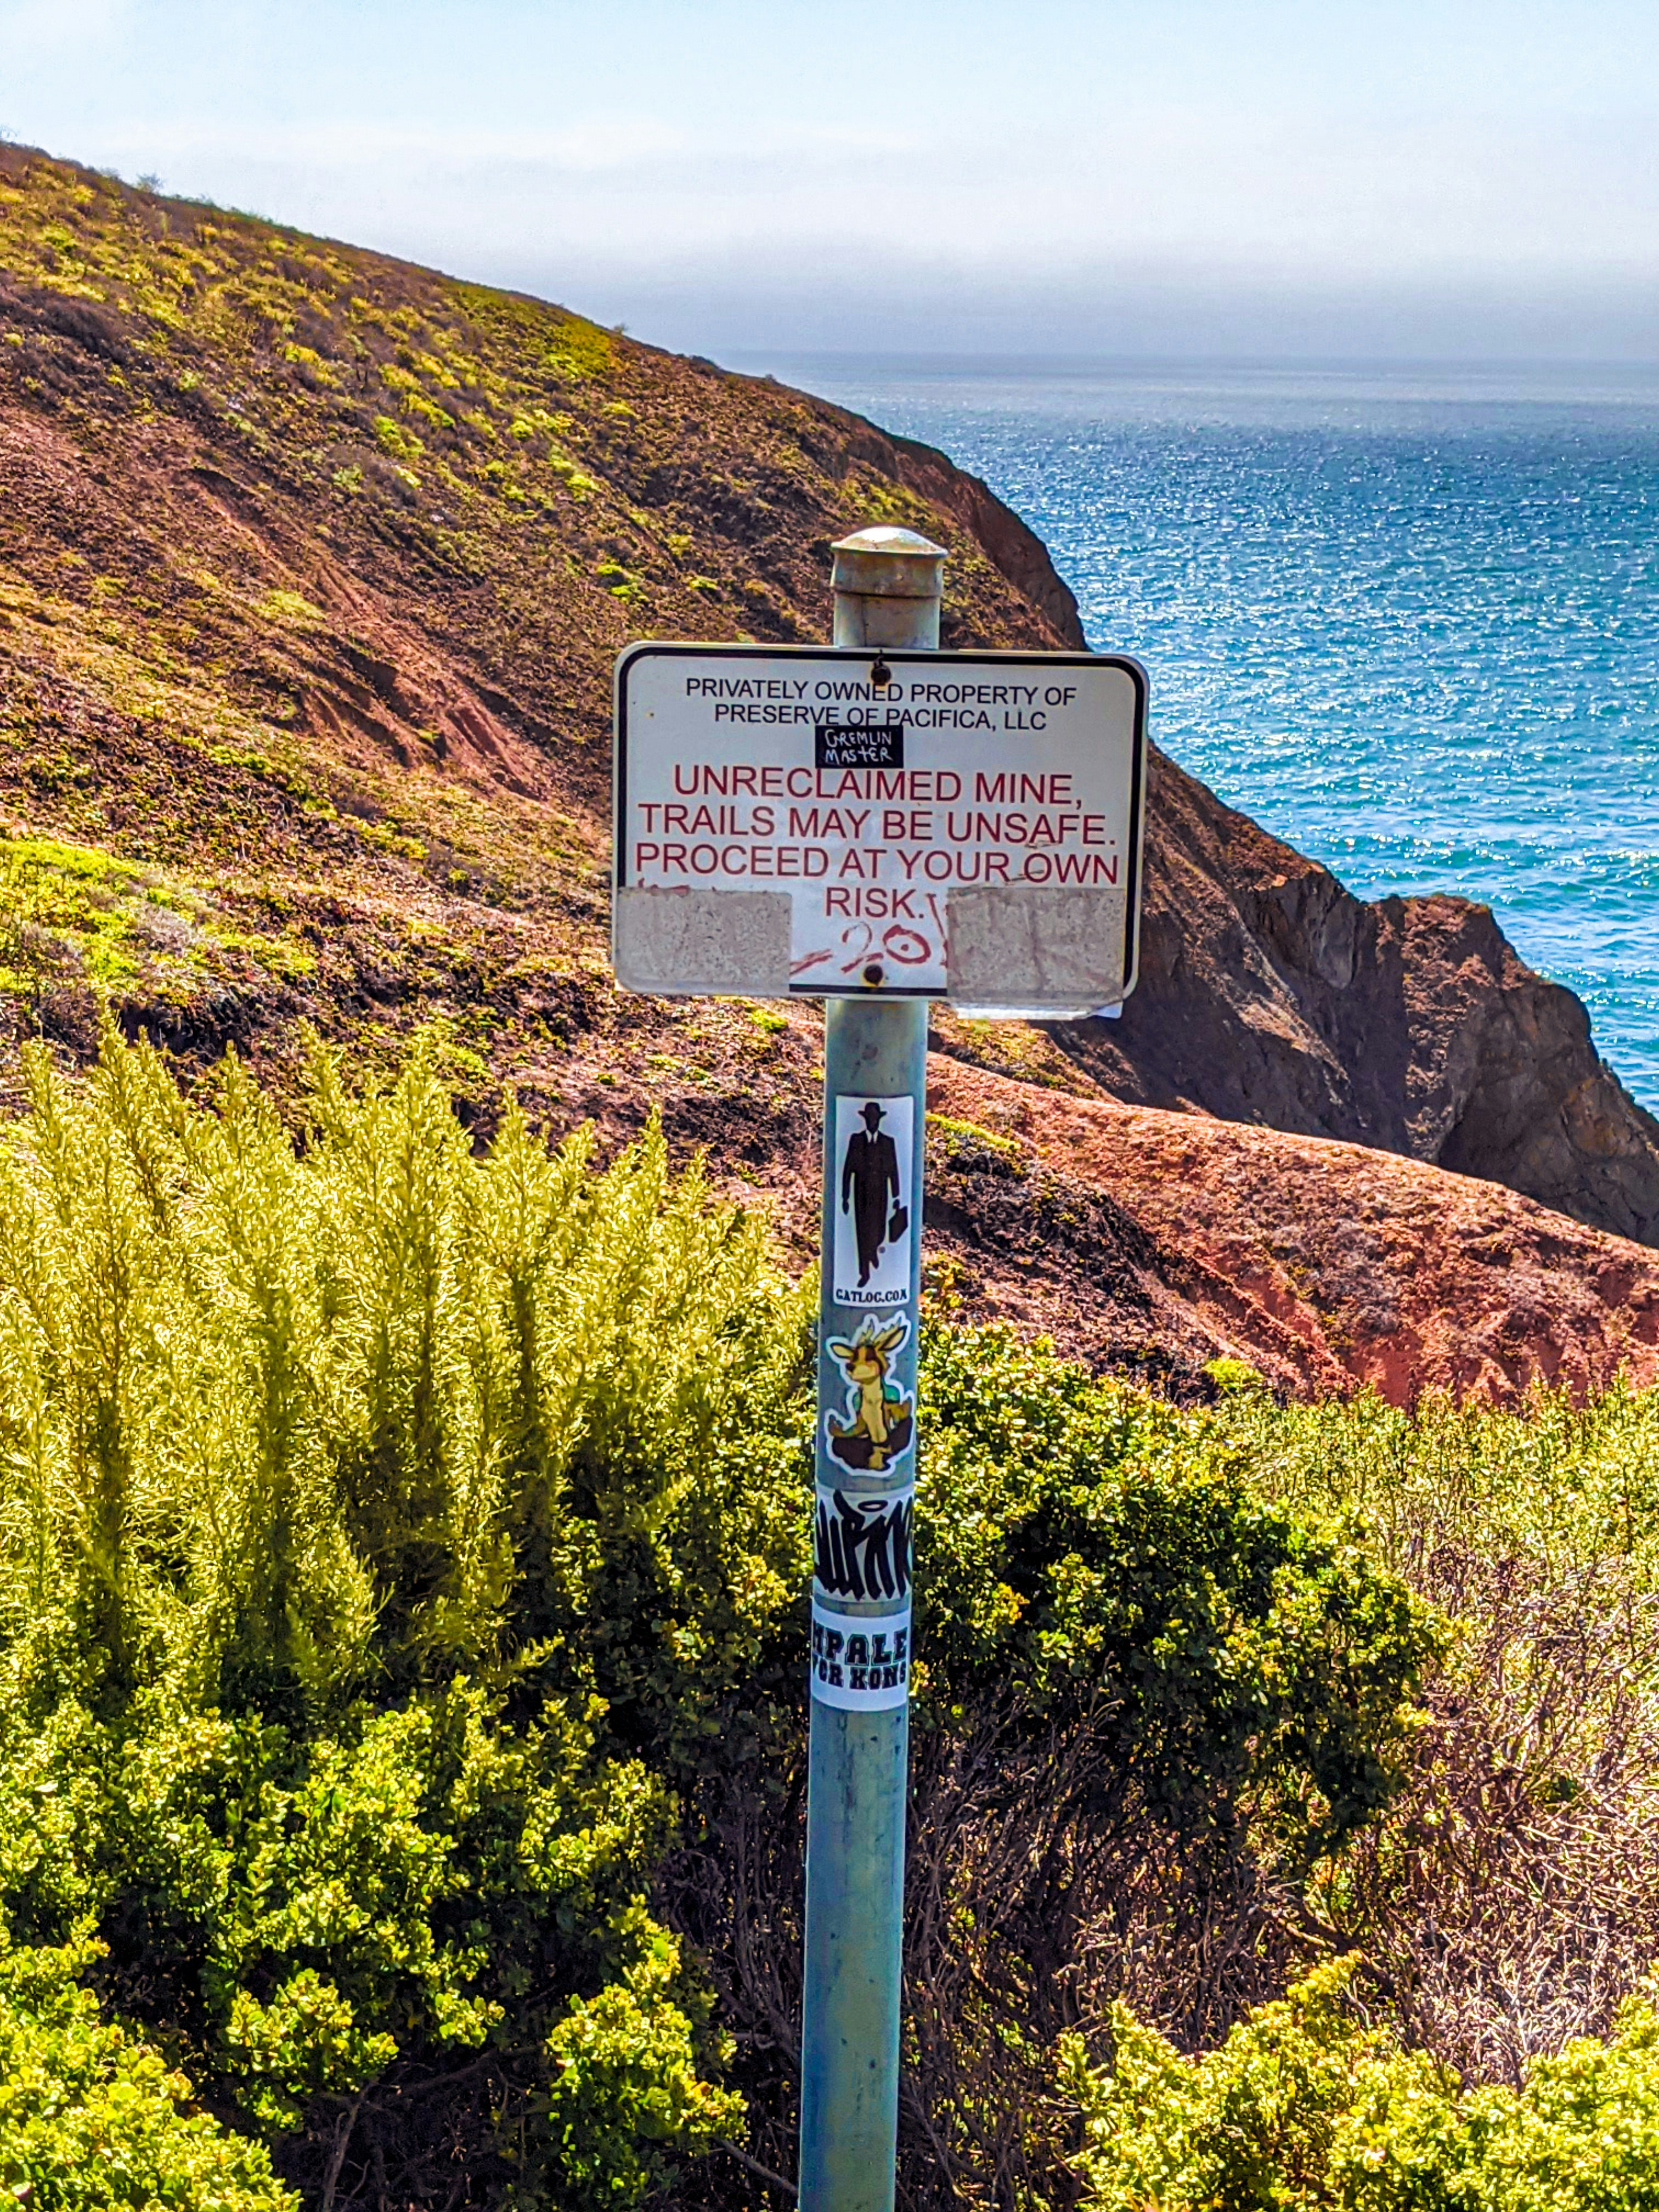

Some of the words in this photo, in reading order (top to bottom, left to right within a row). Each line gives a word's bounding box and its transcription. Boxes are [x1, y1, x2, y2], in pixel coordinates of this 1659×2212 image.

[686, 678, 809, 699] PRIVATELY
[815, 681, 904, 702] OWNED
[911, 684, 1039, 706] PROPERTY
[1044, 686, 1077, 706] OF
[715, 703, 839, 725] PRESERVE
[848, 707, 880, 726] OF
[886, 708, 996, 732] PACIFICA,
[1004, 710, 1047, 731] LLC
[825, 729, 892, 748] GREMLIN
[675, 764, 962, 802] UNRECLAIMED
[975, 772, 1082, 810] MINE,
[637, 803, 775, 837] TRAILS
[789, 808, 871, 839] MAY
[883, 810, 933, 841] BE
[947, 811, 1115, 845] UNSAFE.
[637, 842, 829, 877] PROCEED
[839, 848, 887, 878] AT
[896, 849, 1009, 883] YOUR
[1024, 852, 1118, 885] OWN
[826, 887, 924, 919] RISK.
